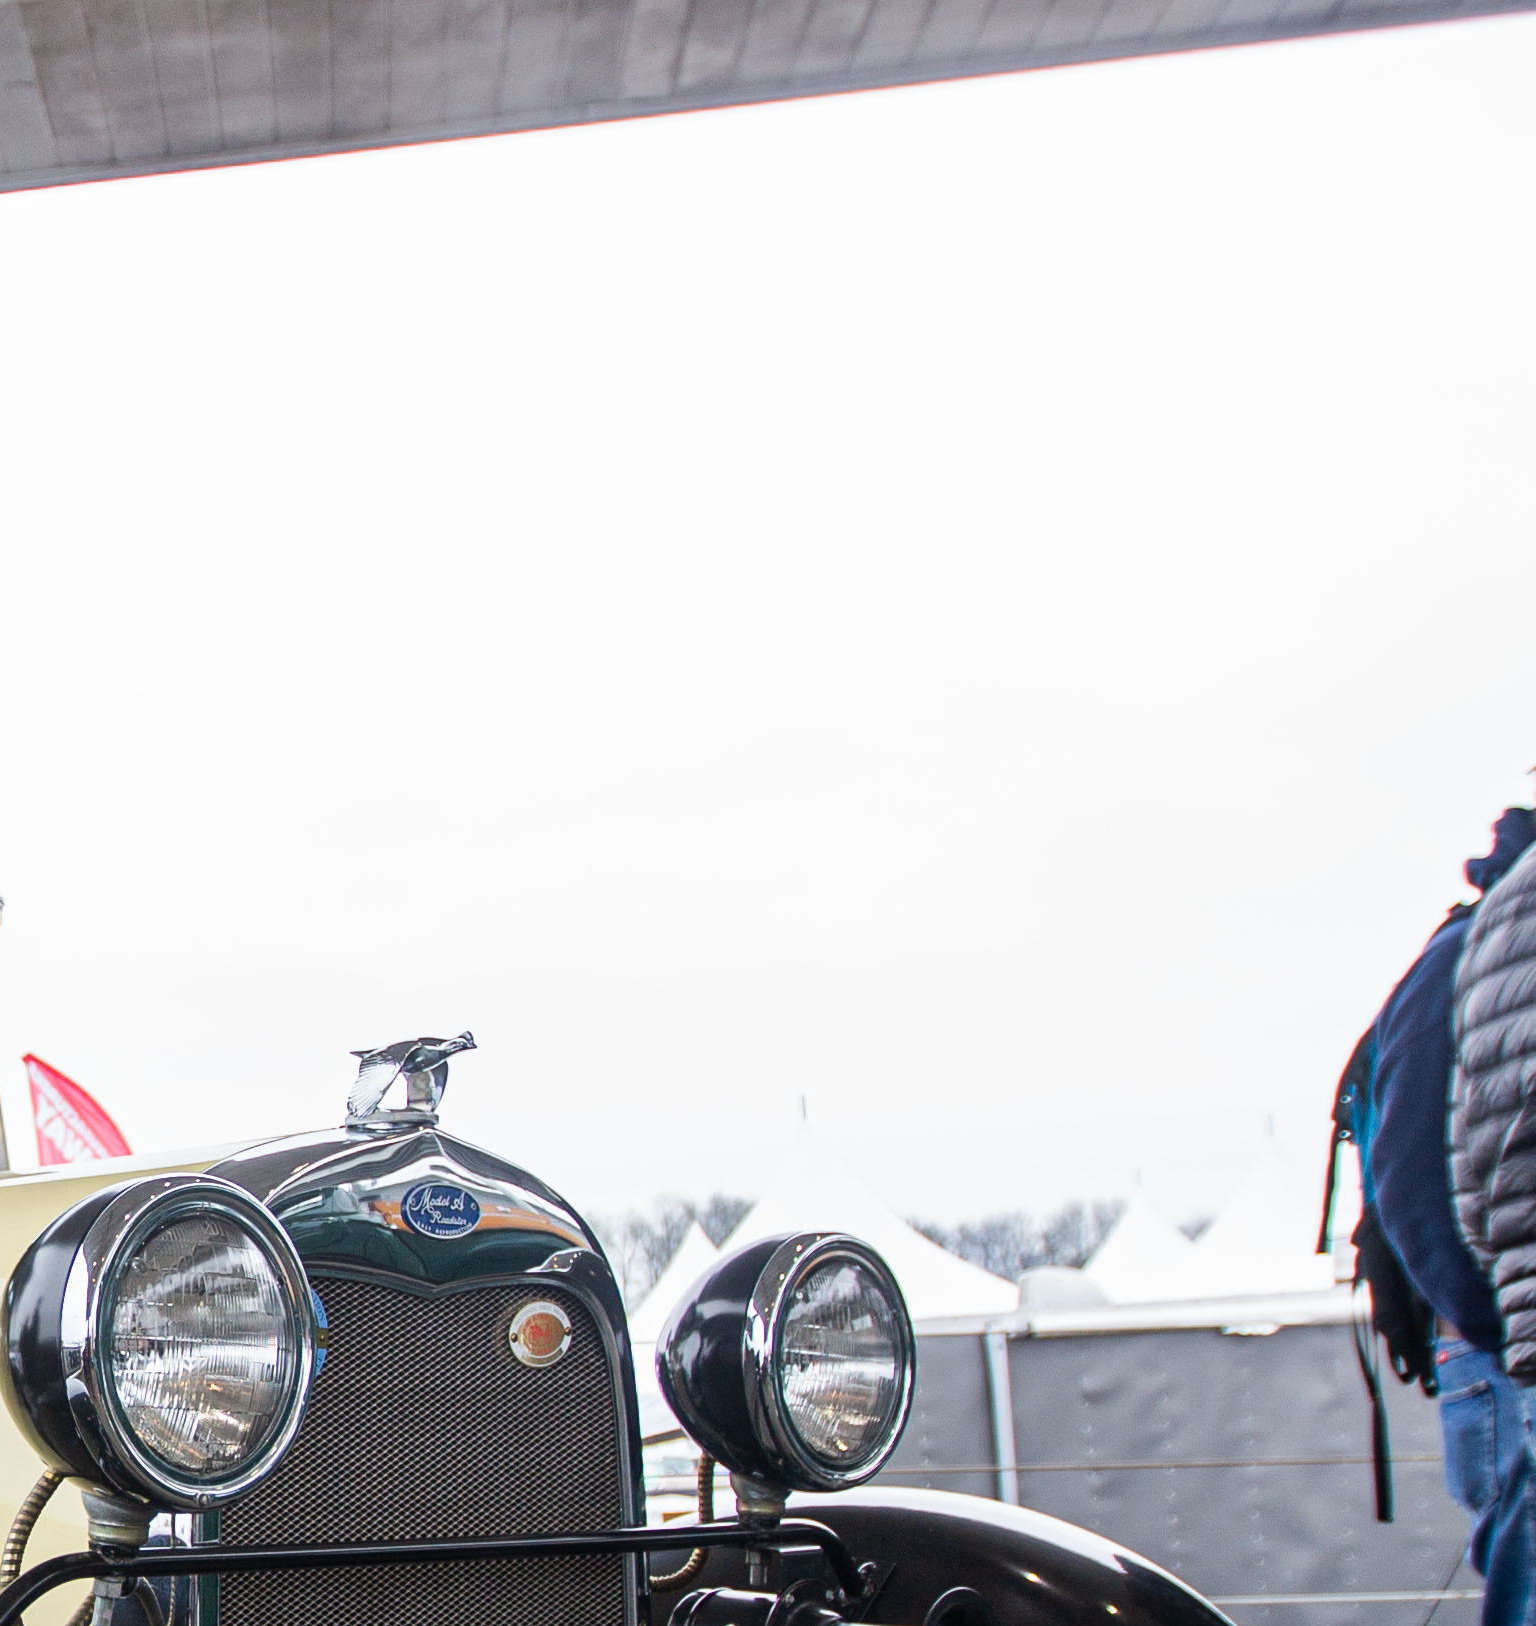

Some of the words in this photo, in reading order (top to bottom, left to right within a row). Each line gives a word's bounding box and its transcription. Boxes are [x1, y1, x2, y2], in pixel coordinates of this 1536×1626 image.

[410, 1187, 450, 1215] Model
[450, 1192, 466, 1211] A
[430, 1211, 467, 1226] Roadster
